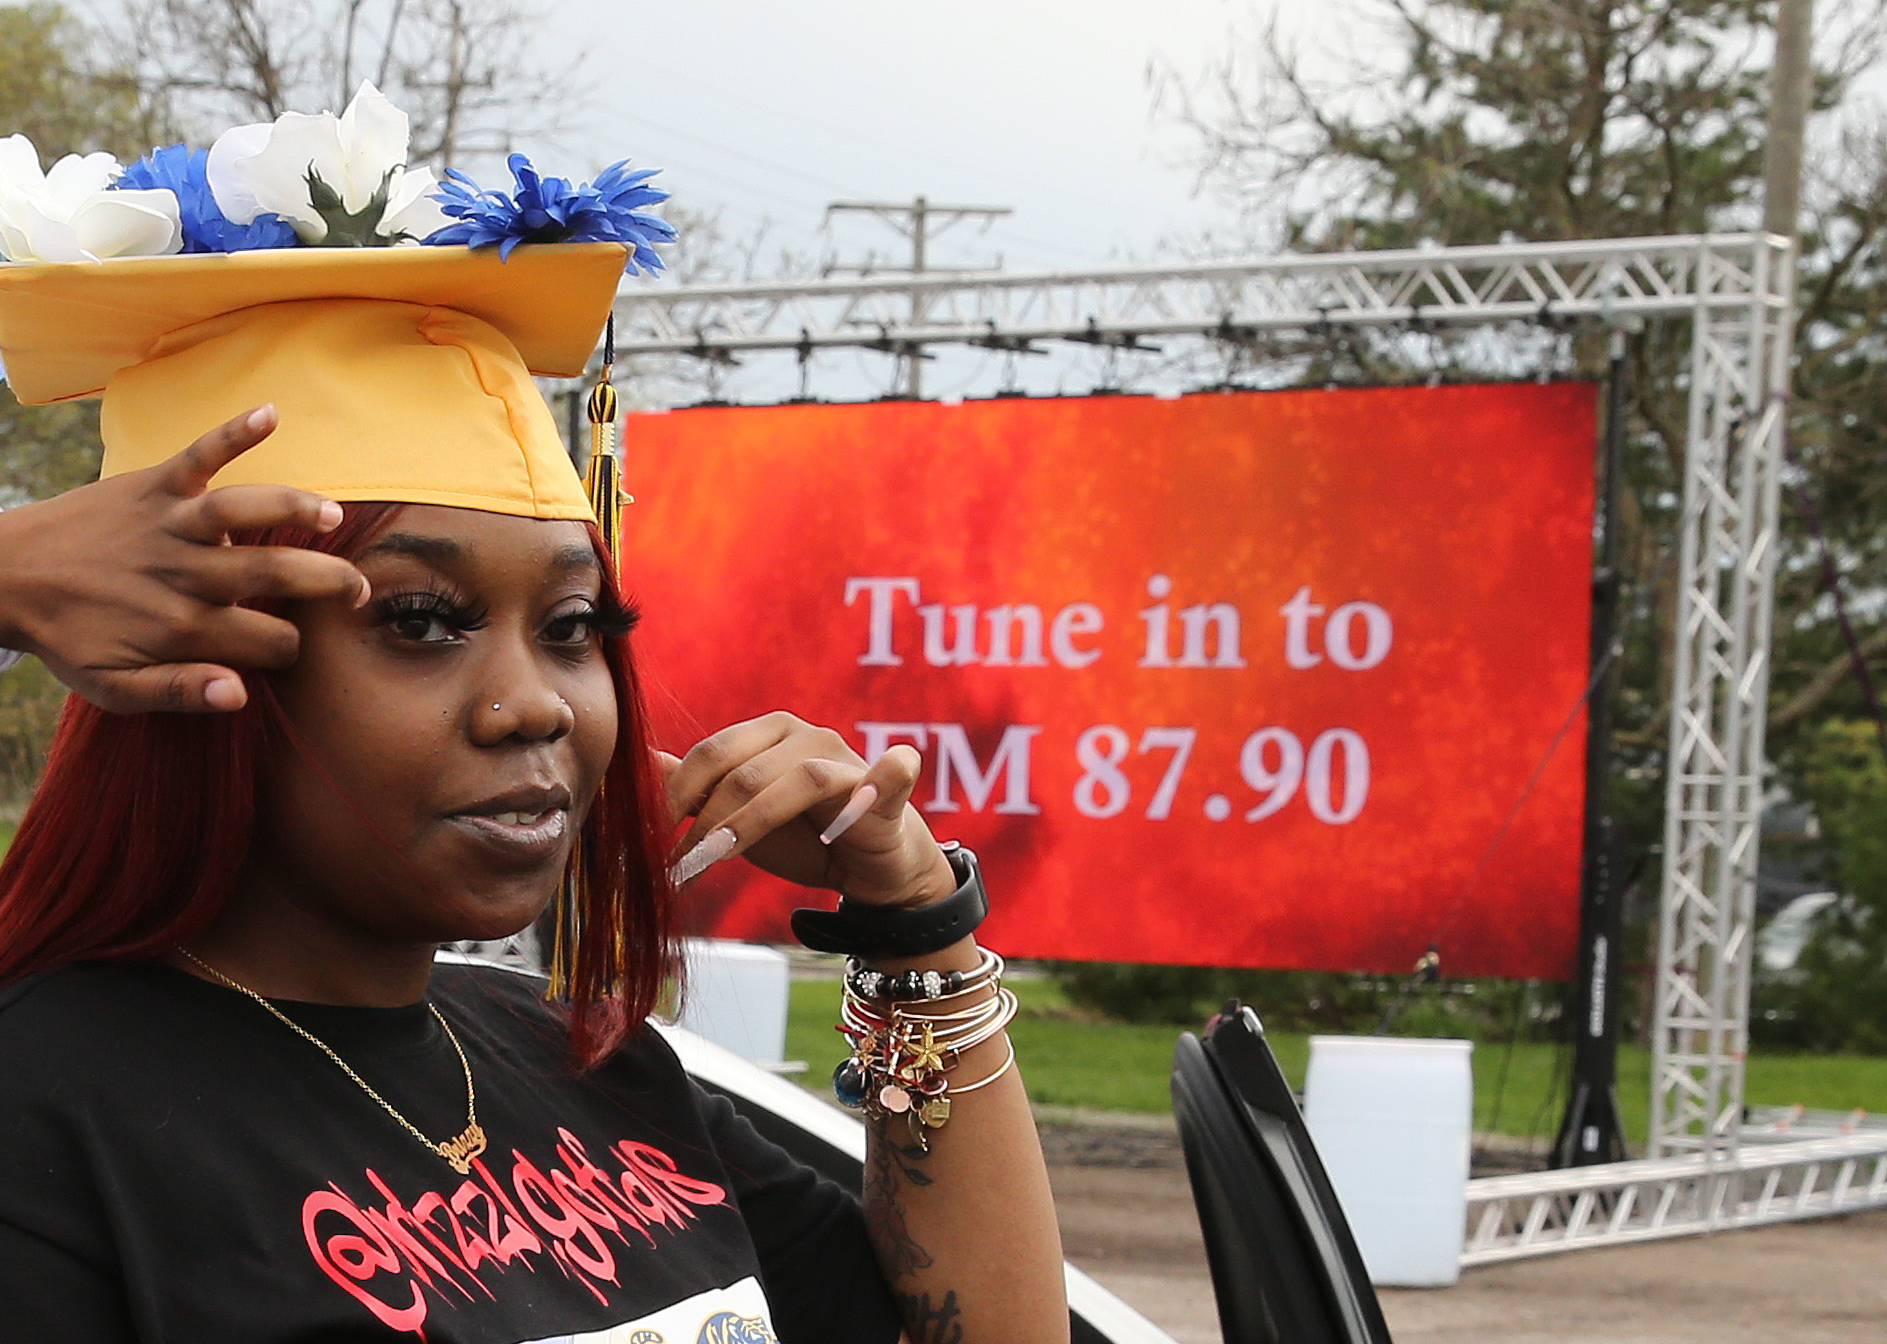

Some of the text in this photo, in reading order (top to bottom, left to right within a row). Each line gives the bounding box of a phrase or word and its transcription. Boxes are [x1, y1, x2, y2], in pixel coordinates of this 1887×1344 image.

[844, 575, 1394, 671] Tune in to
[854, 722, 1371, 825] FM 87.90
